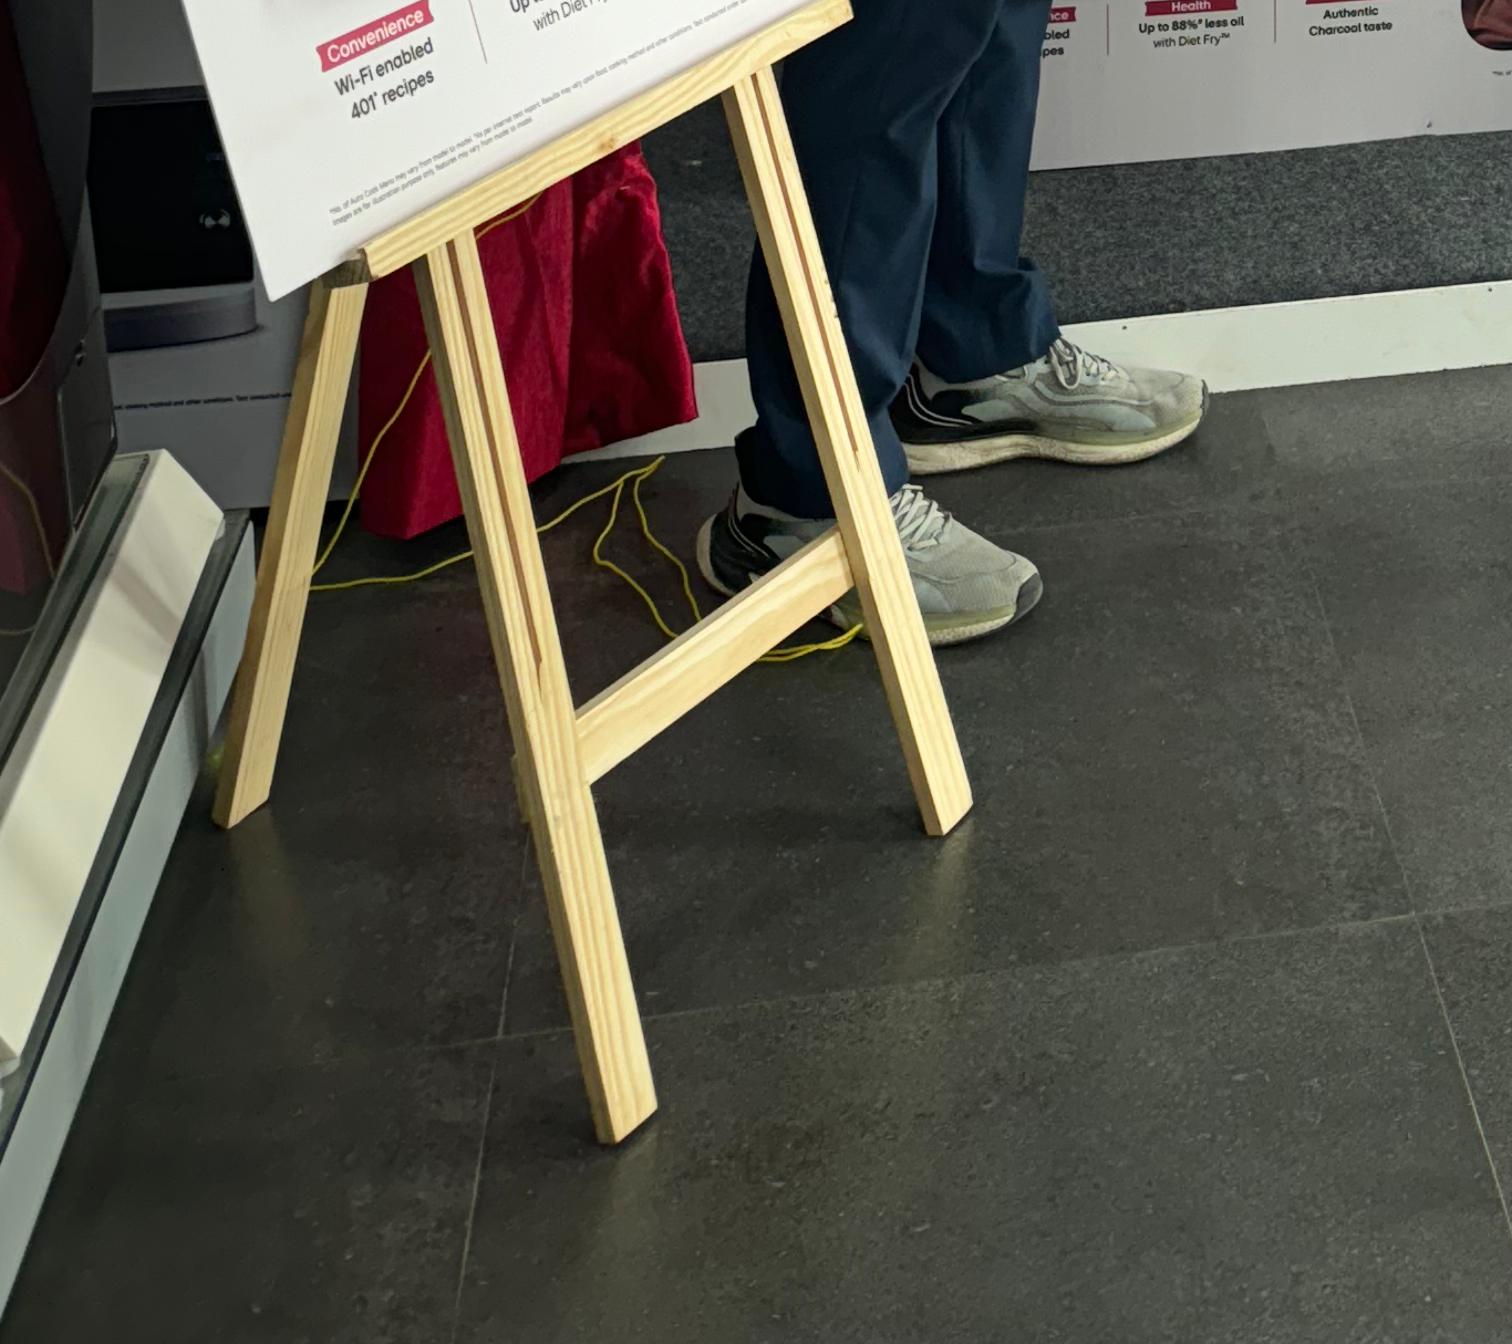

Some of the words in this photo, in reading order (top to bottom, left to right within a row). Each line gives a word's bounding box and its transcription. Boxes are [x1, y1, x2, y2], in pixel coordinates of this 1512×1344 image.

[1171, 0, 1211, 12] Health
[1323, 6, 1378, 19] Authentic
[533, 5, 561, 32] with
[1139, 24, 1155, 35] Up
[1159, 22, 1169, 31] to
[1205, 17, 1228, 29] less
[1230, 16, 1244, 26] oil
[326, 9, 425, 63] Convenience
[1309, 23, 1362, 36] Charcoal
[1364, 22, 1392, 31] taste
[1153, 38, 1176, 48] with
[1178, 35, 1201, 47] Diet
[334, 65, 374, 96] Wi-Fi
[375, 37, 434, 78] enabled
[382, 71, 434, 105] recipes
